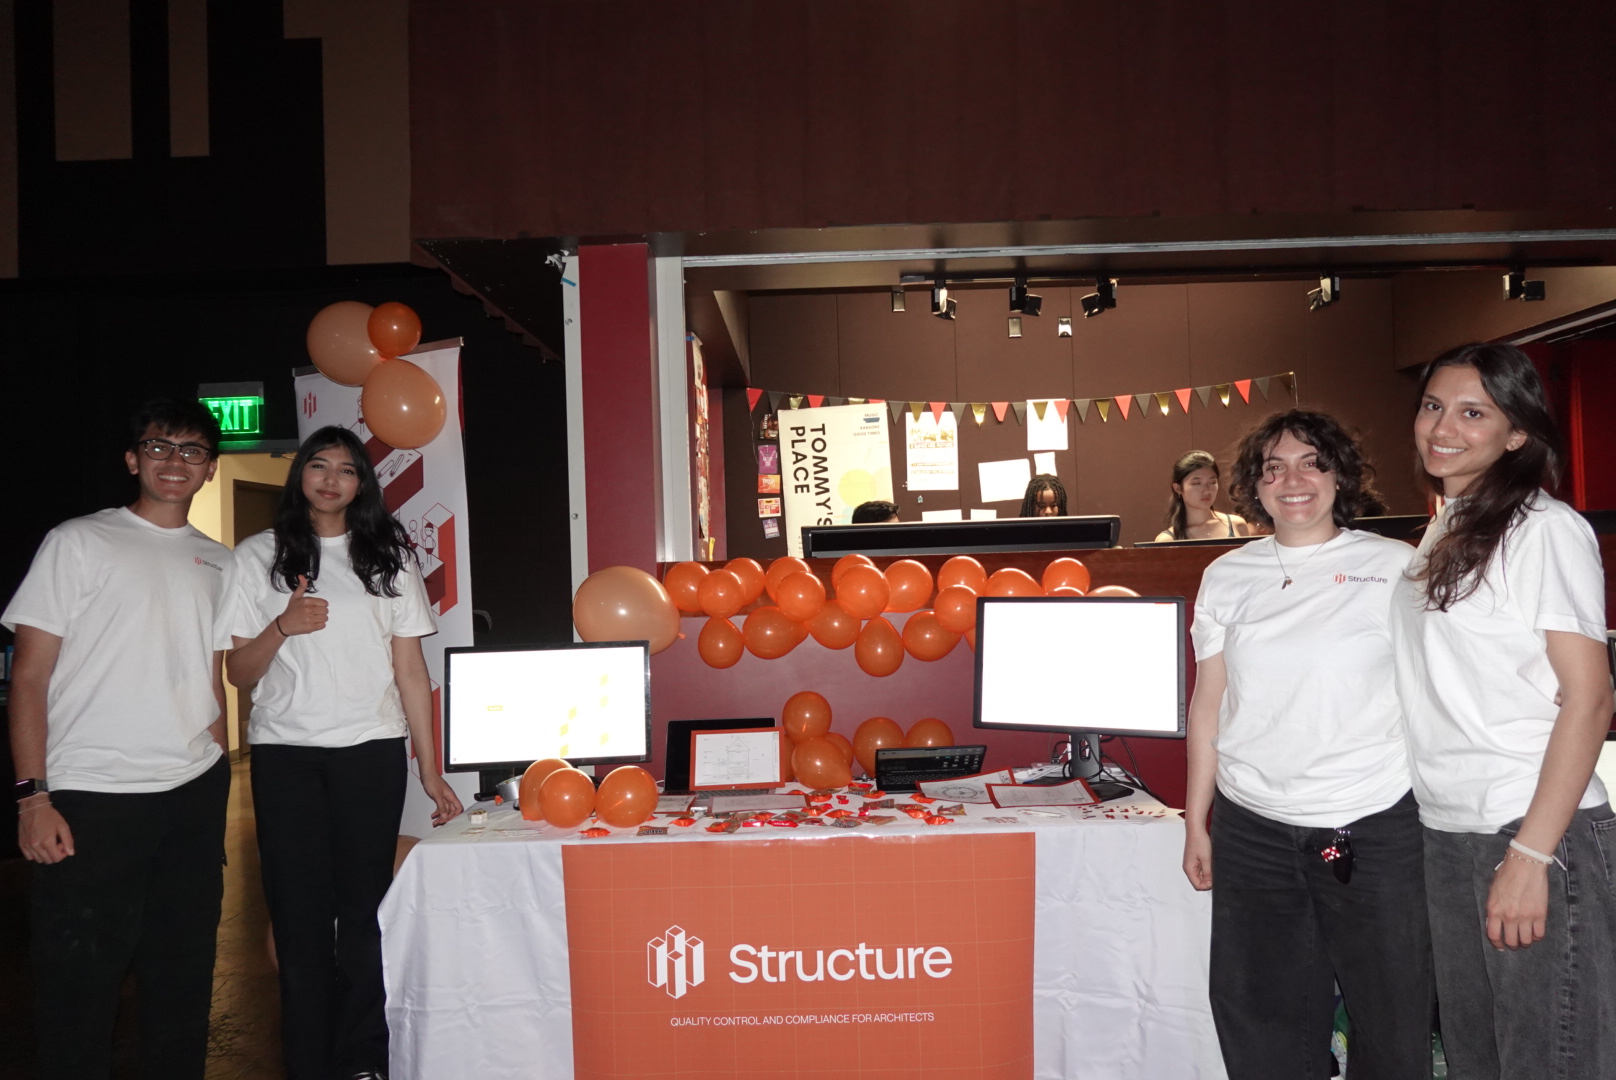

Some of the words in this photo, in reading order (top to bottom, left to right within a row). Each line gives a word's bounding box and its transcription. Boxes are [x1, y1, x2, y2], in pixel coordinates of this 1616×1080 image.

[207, 400, 252, 430] EXIT
[790, 426, 810, 494] PLACE
[810, 423, 834, 525] TOMMY'S
[1348, 576, 1388, 584] Structure
[729, 942, 953, 984] Structure
[670, 1016, 711, 1027] QUALITY
[713, 1015, 761, 1026] CONTROL
[762, 1015, 783, 1025] AND
[785, 1013, 850, 1025] COMPLIANCE
[851, 1013, 872, 1023] FOR
[873, 1012, 935, 1023] ARCHITECTS
